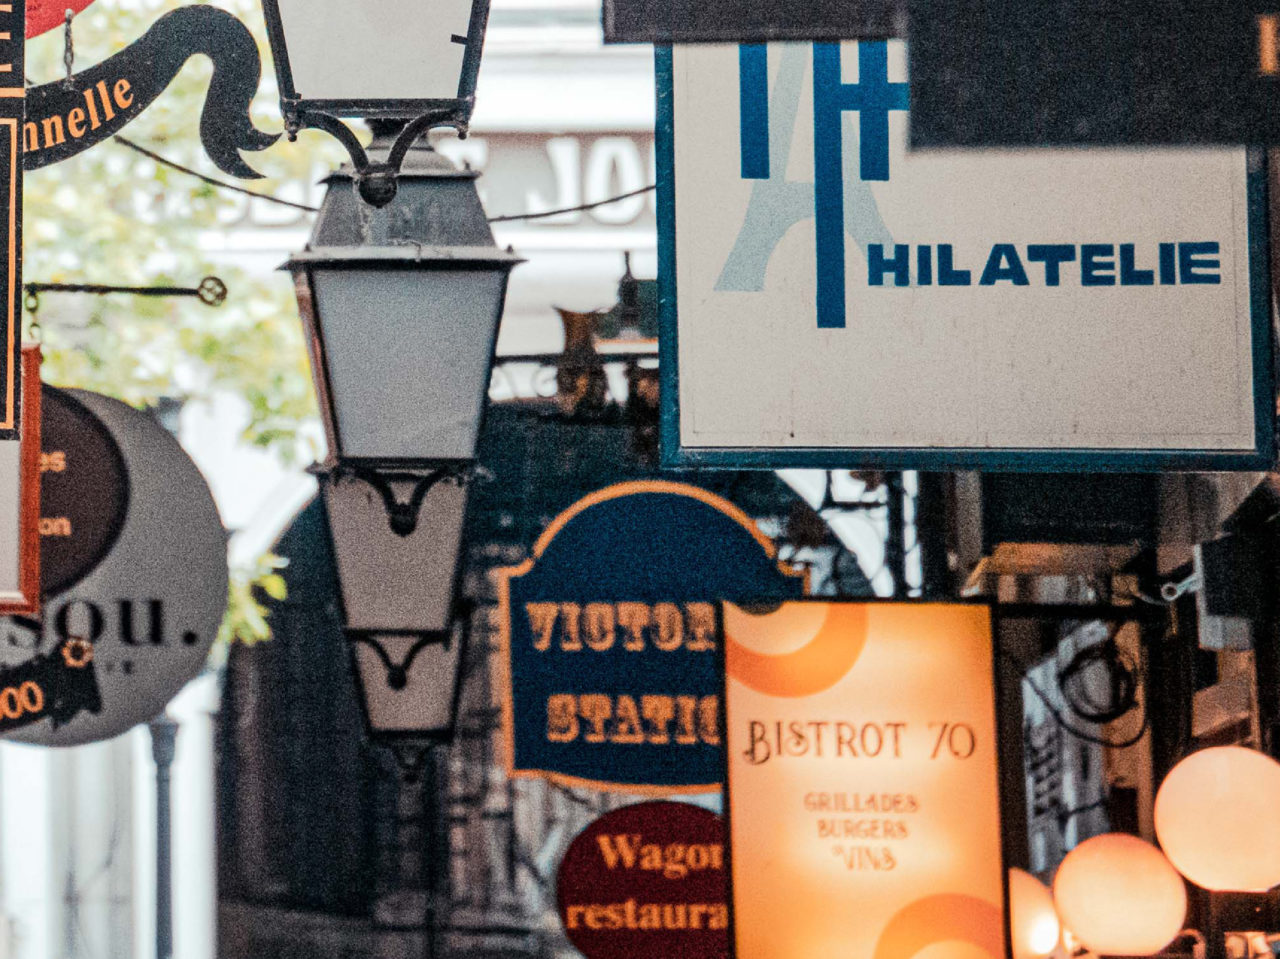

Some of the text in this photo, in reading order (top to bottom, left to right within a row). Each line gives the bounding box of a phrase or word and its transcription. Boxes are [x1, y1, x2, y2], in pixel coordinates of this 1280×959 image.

[23, 78, 134, 153] nnelle
[742, 721, 907, 765] BISTROT
[803, 792, 921, 814] GRILLADES
[816, 819, 909, 839] BURGERS
